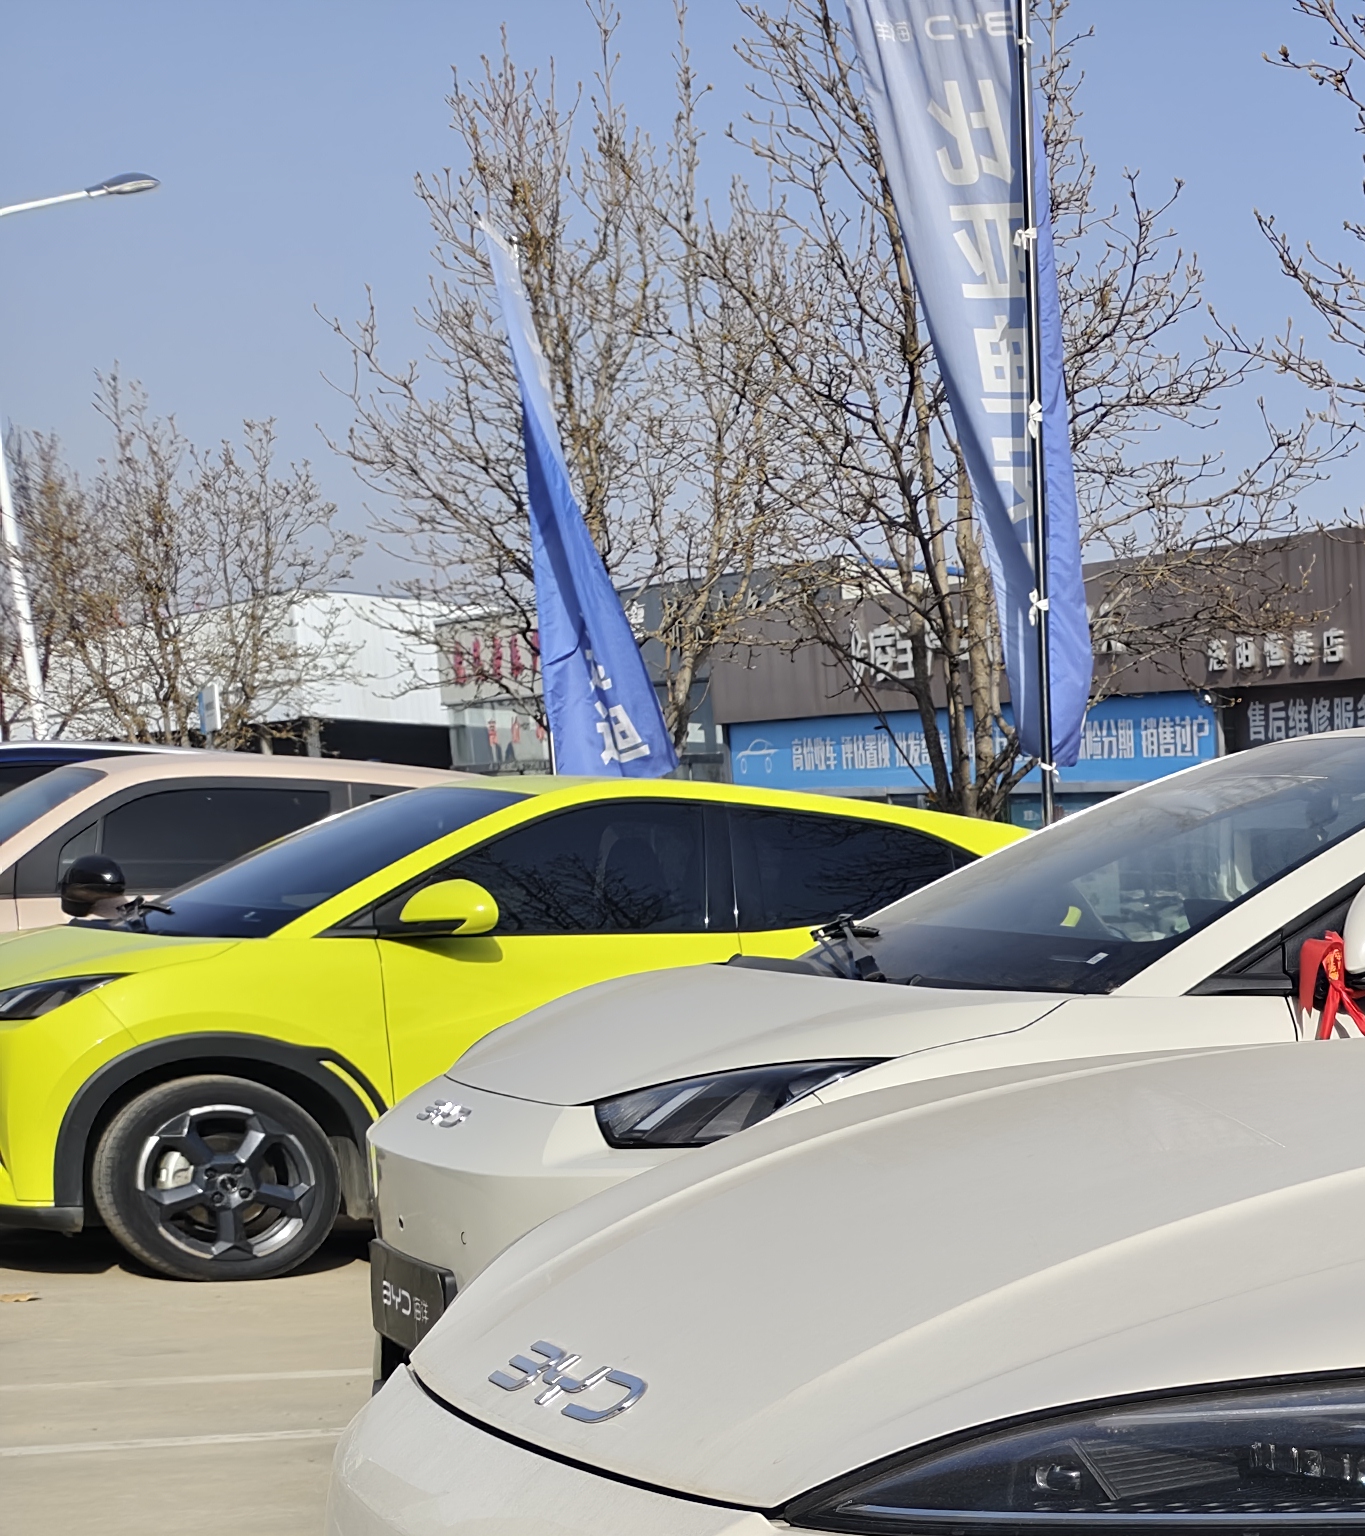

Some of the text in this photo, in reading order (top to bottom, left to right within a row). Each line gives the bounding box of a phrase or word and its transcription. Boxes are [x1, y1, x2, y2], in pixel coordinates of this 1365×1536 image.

[1141, 715, 1209, 758] 销售过户
[382, 1279, 412, 1316] BYD
[488, 1340, 648, 1424] BYD
